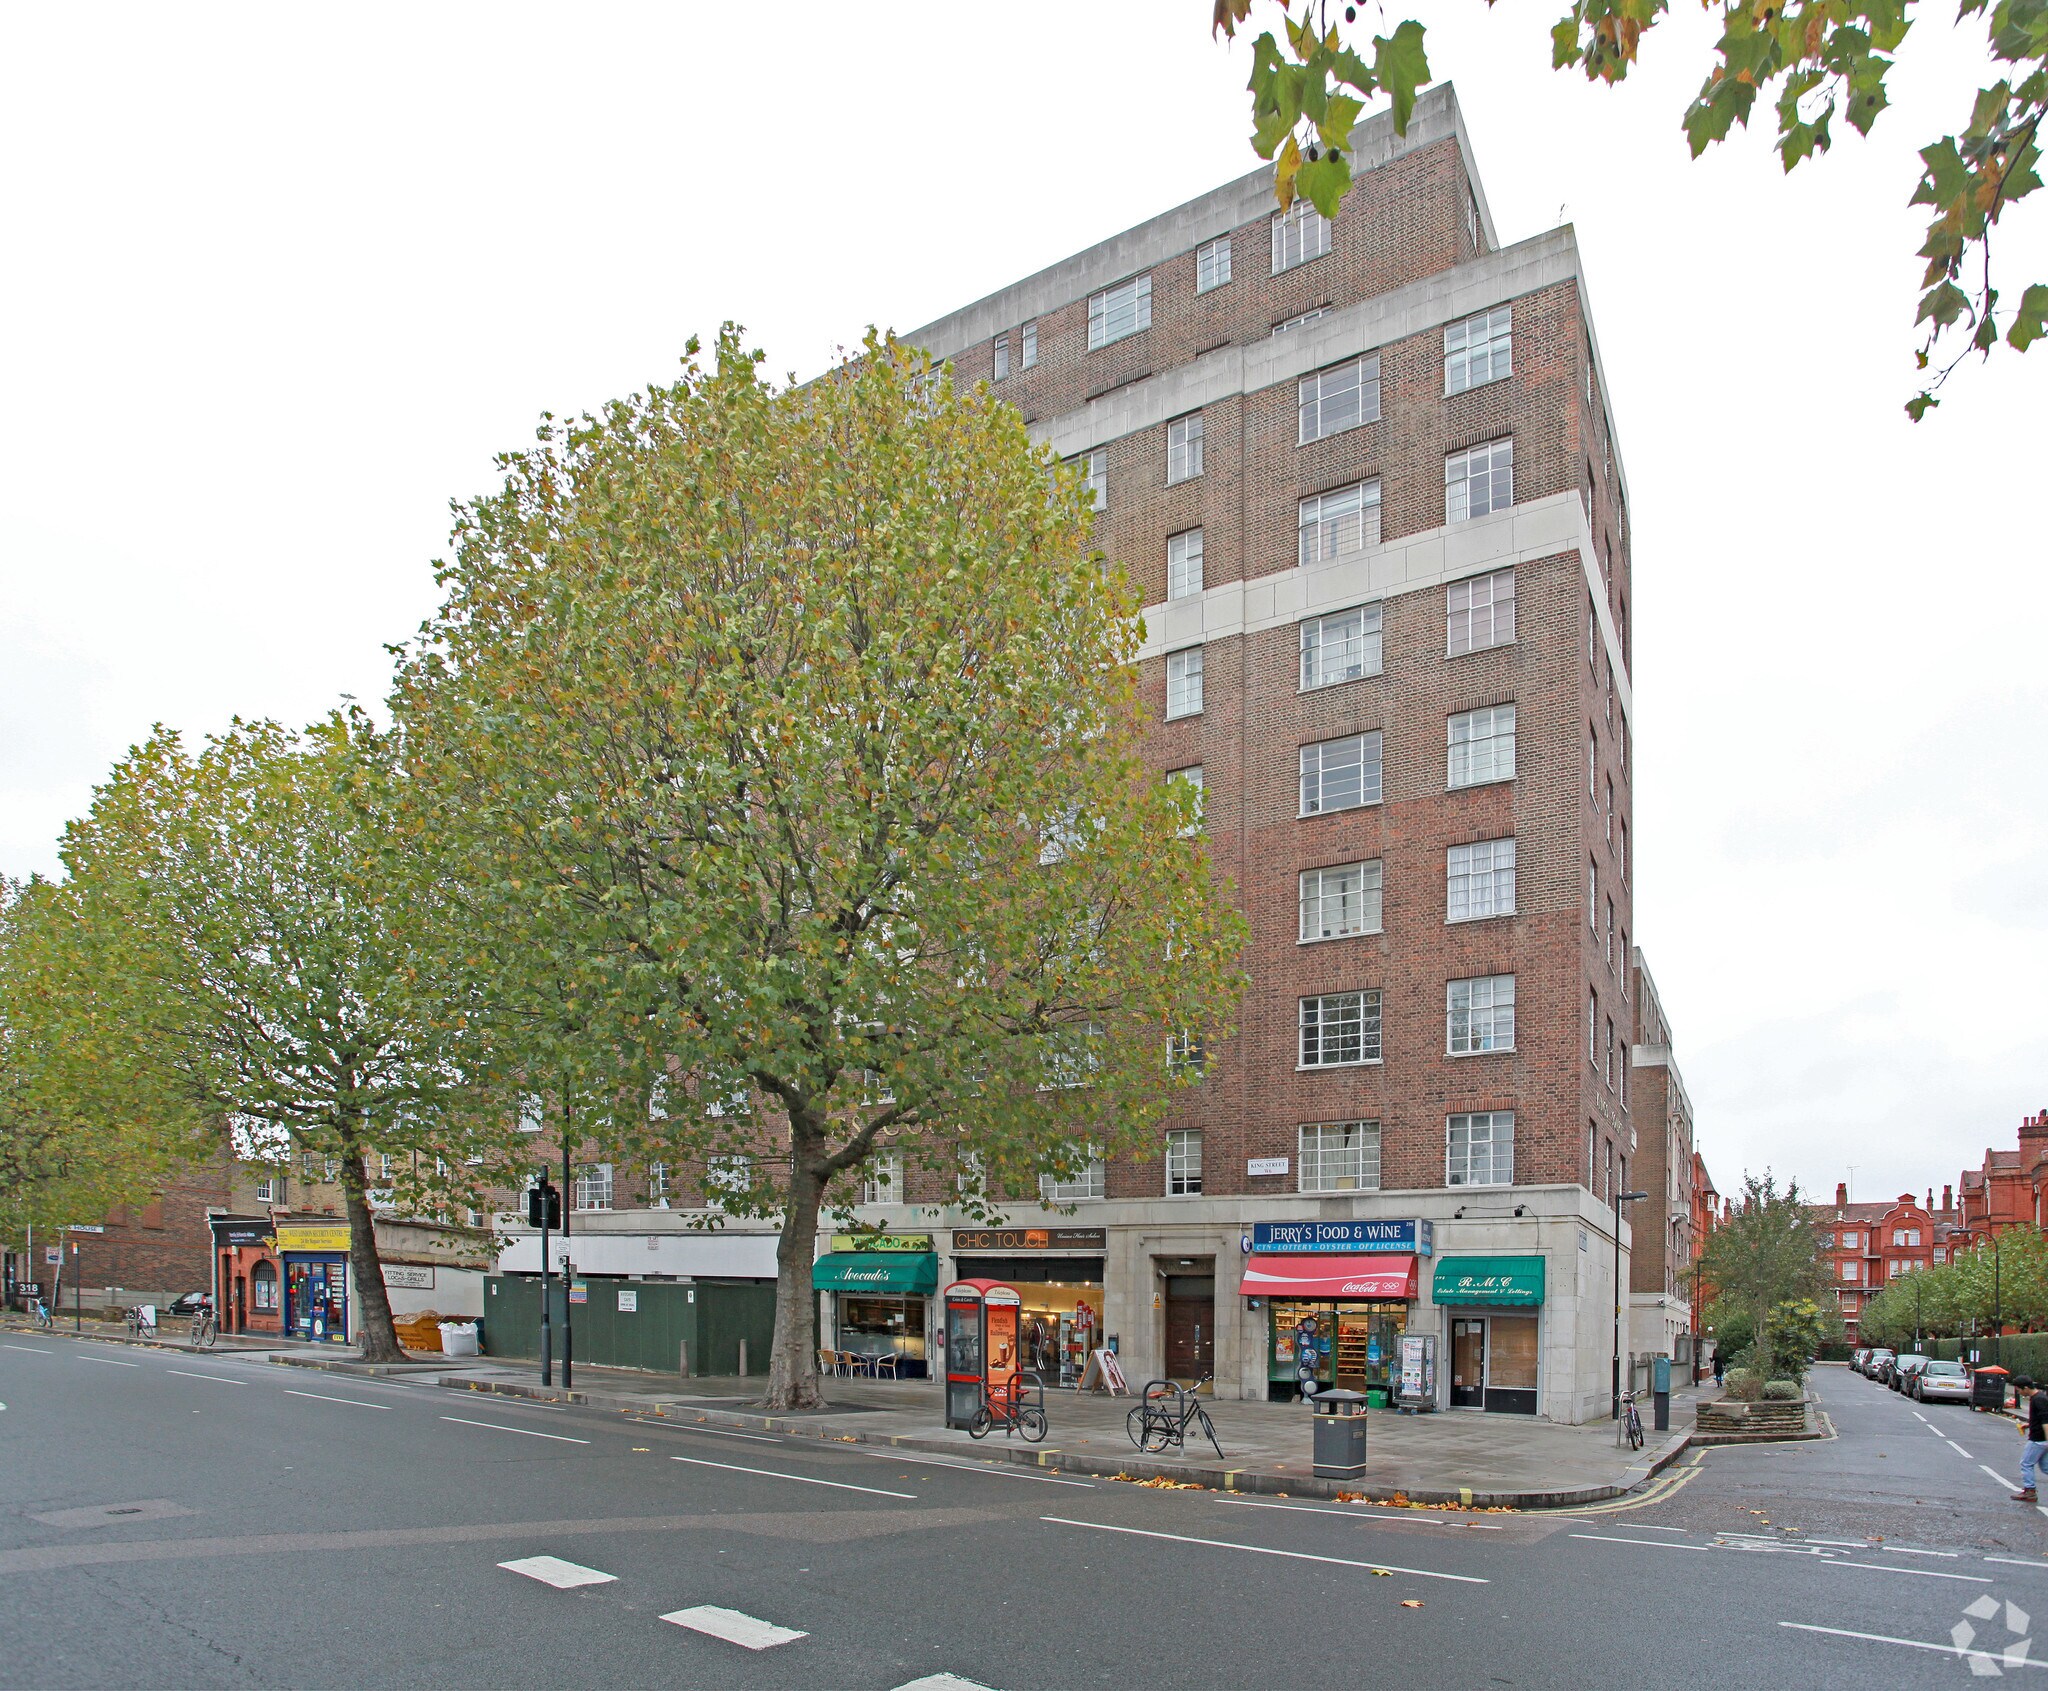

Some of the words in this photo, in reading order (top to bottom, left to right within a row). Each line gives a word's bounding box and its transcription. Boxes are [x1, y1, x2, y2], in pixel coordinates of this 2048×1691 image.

[956, 1233, 990, 1248] CHIC
[995, 1232, 1049, 1248] TOUCH
[1269, 1224, 1312, 1243] JERRY'S
[1316, 1224, 1349, 1242] FOOD
[1353, 1226, 1362, 1239] &
[1367, 1223, 1401, 1239] WINE
[834, 1267, 890, 1280] Avocado's
[20, 1284, 38, 1292] 318
